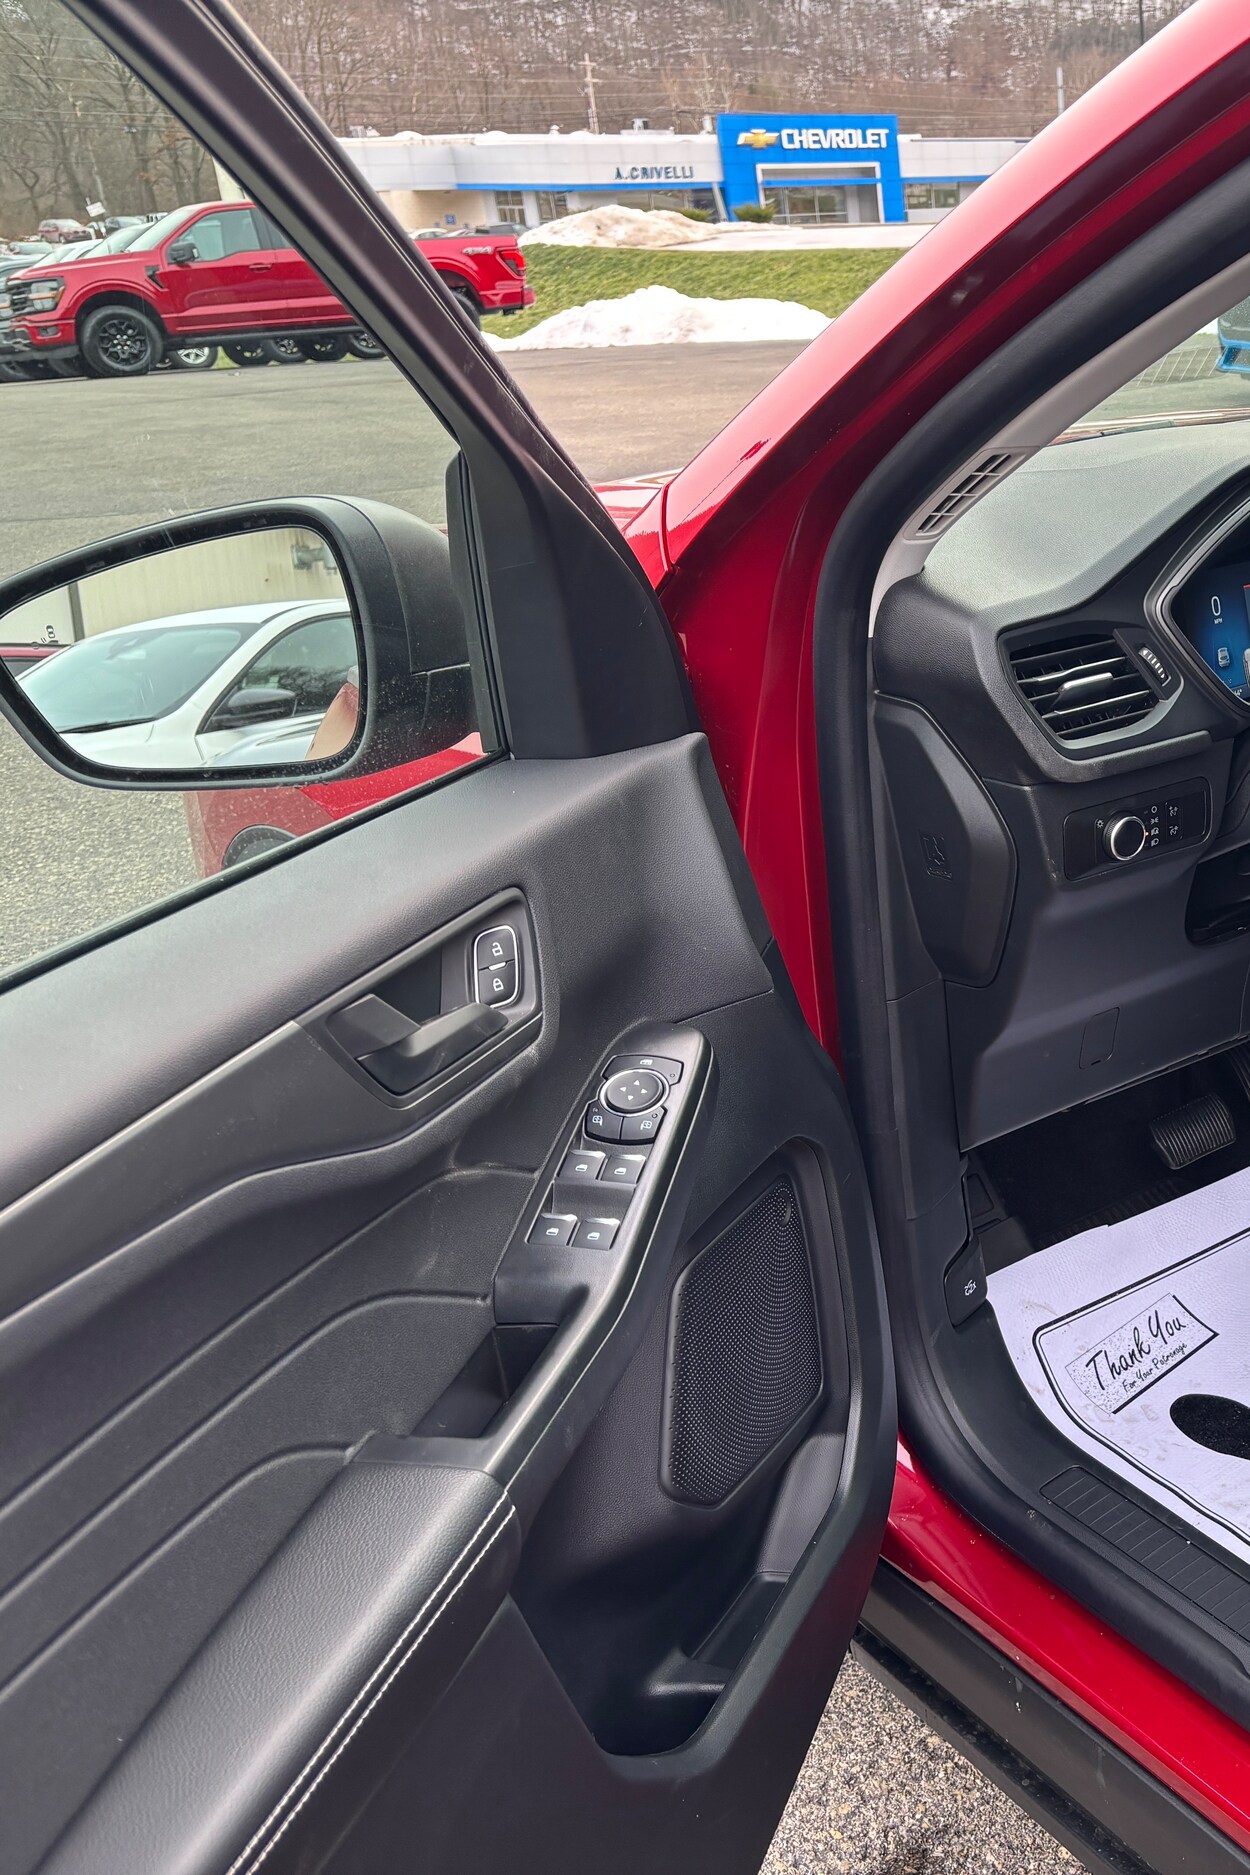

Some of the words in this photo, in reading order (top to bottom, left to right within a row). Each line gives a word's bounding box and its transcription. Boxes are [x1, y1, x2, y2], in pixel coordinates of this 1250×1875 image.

[780, 128, 890, 150] CHEVROLET
[1085, 1326, 1151, 1391] Thank
[1148, 1309, 1187, 1345] You
[1121, 1379, 1137, 1393] For
[1135, 1367, 1154, 1382] Your
[1151, 1342, 1188, 1370] Patronage
